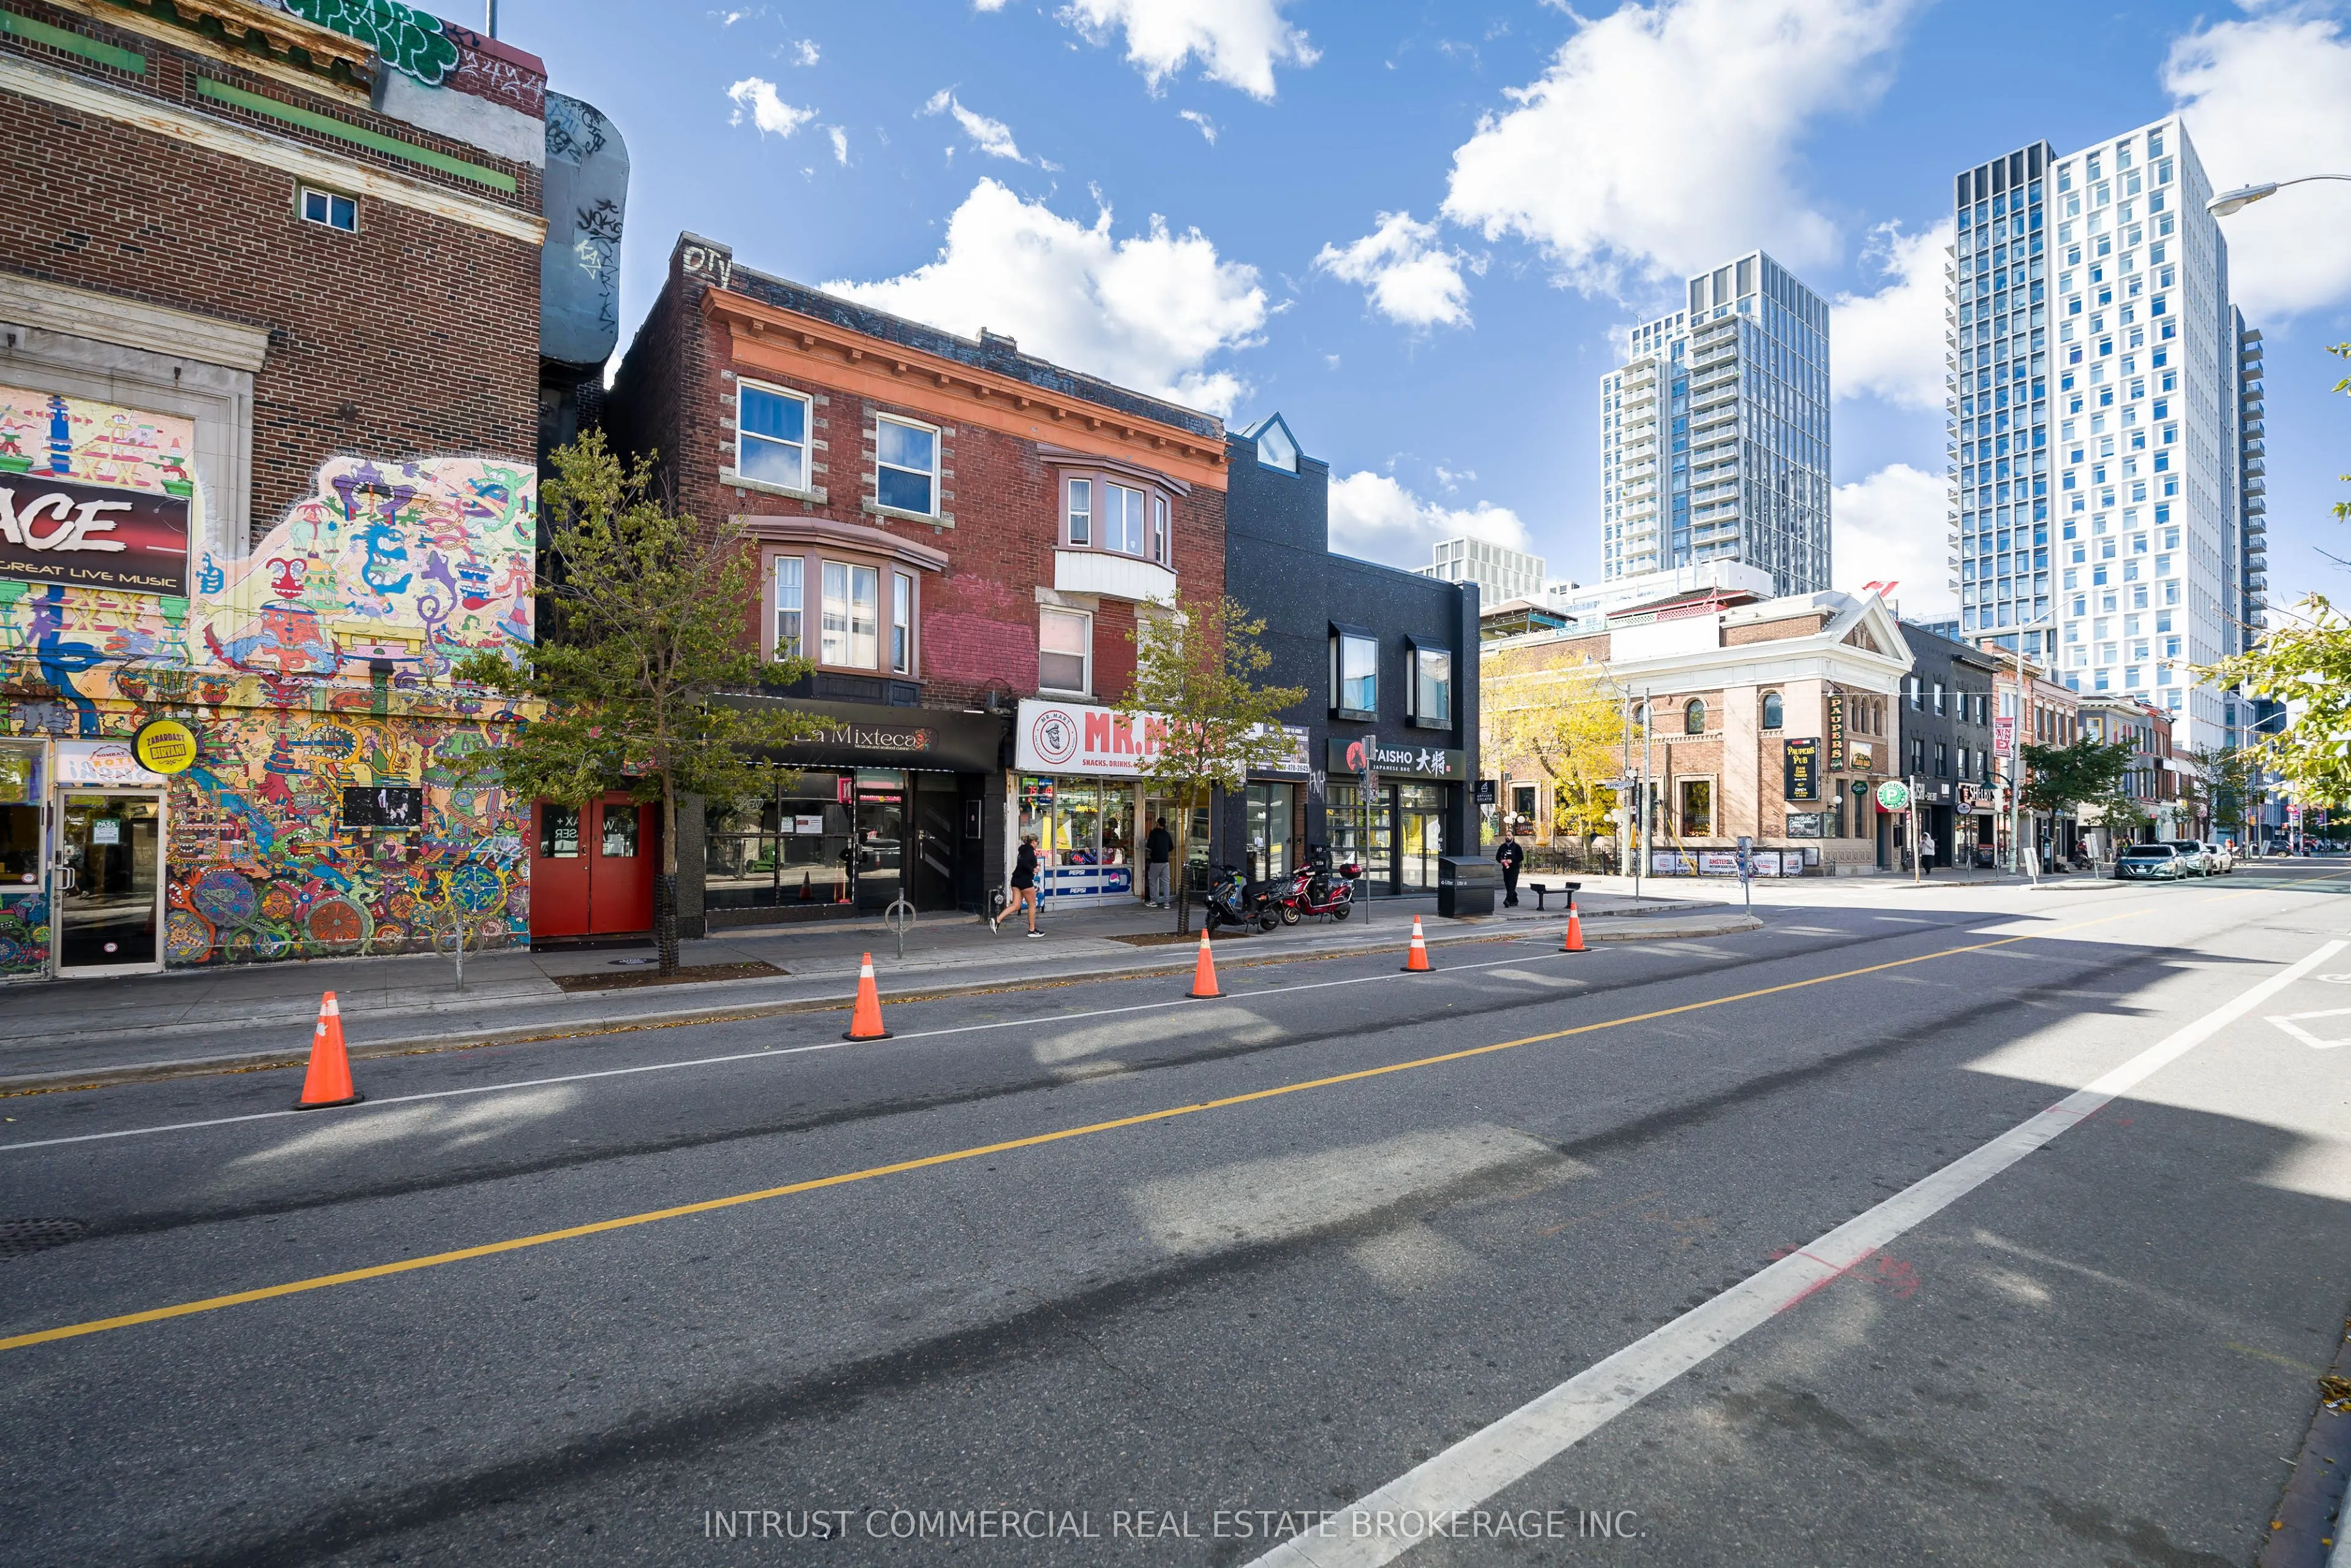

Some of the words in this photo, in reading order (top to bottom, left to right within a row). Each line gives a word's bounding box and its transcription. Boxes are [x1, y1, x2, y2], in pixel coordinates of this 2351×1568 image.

[0, 561, 64, 576] GREAT
[70, 568, 113, 580] LIVE
[119, 574, 177, 588] MUSIC
[832, 725, 916, 747] Mixteca
[1085, 711, 1226, 757] MR.MAR
[1831, 699, 1842, 758] PAUPERS
[147, 733, 185, 746] ZABARDAST
[151, 744, 186, 759] BIRYANI
[1373, 749, 1413, 764] TAISHO
[1787, 746, 1815, 756] PAUPERS
[92, 757, 132, 767] ROTI
[1082, 759, 1108, 768] SNACKS,
[1793, 755, 1808, 764] PUB
